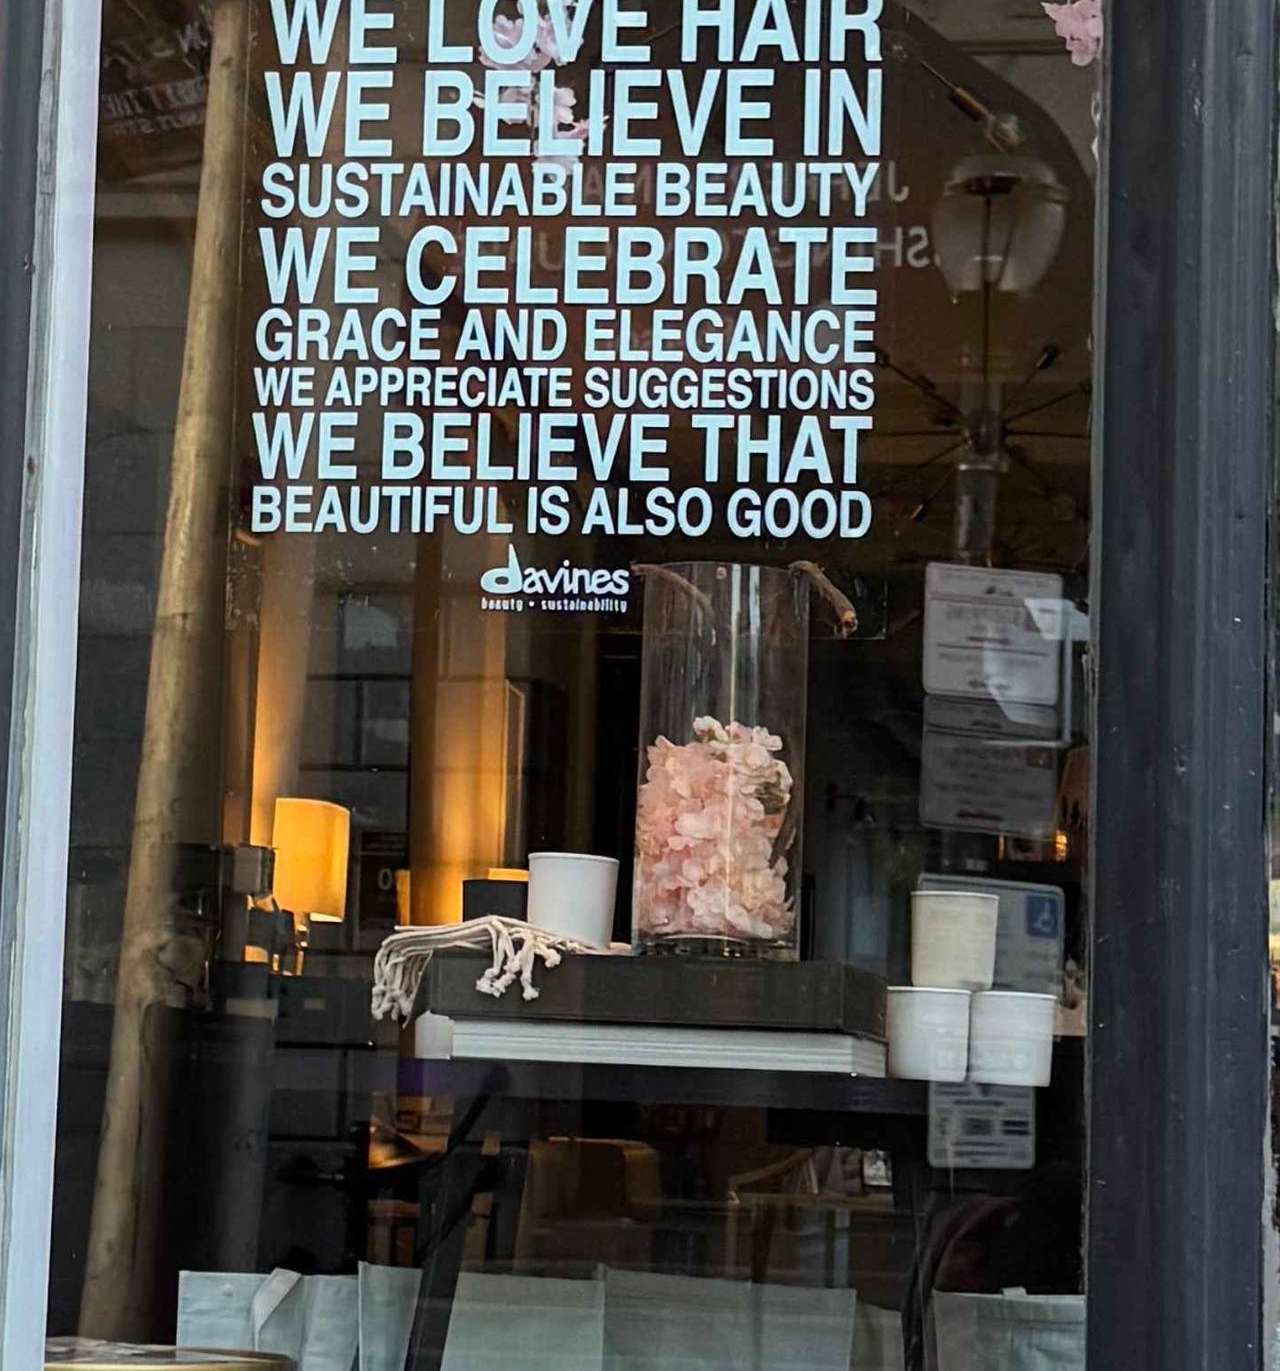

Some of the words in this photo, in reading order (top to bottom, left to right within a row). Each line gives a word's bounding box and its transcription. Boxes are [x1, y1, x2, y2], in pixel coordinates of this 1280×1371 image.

[264, 71, 392, 157] WE
[423, 69, 774, 160] BELIEVE
[804, 69, 881, 155] IN
[262, 162, 635, 217] SUSTAINABLE
[656, 163, 878, 217] BEAUTY
[257, 227, 378, 303] WE
[406, 225, 877, 305] CELEBRATE
[256, 308, 440, 361] GRACE
[456, 309, 566, 360] AND
[585, 309, 874, 363] ELEGANCE
[253, 368, 312, 406] WE
[326, 367, 569, 407] APPRECIATE
[585, 368, 873, 409] SUGGESTIONS
[252, 412, 358, 479] WE
[382, 412, 669, 481] BELIEVE
[692, 415, 871, 483] THAT
[252, 486, 511, 533] BEAUTIFUL
[528, 487, 569, 534] IS
[583, 488, 712, 536] ALSO
[728, 489, 871, 538] GOOD
[480, 543, 629, 595] davines
[480, 597, 524, 612] beauty
[540, 597, 628, 614] sustainability
